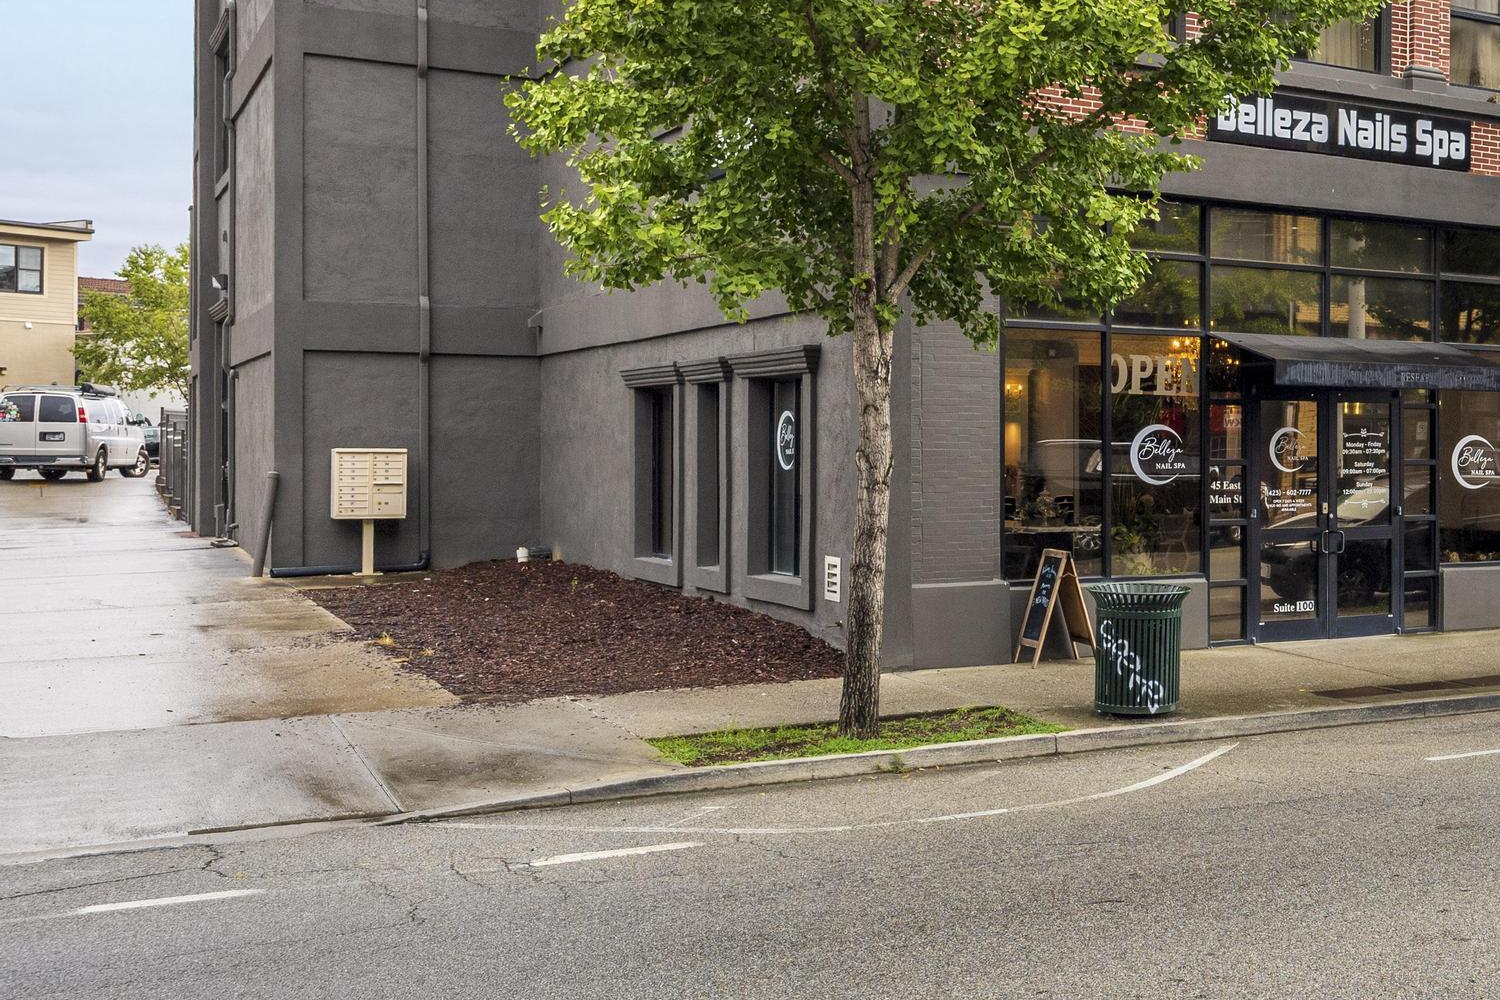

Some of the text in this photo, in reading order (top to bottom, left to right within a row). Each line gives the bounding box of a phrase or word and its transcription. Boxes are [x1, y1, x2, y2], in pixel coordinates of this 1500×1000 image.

[1338, 108, 1407, 153] Nails
[1416, 119, 1465, 166] Spa
[1139, 436, 1184, 462] Belleza
[1345, 441, 1364, 449] Monday
[1458, 446, 1494, 470] Belleza
[1210, 480, 1241, 490] 45 East
[1286, 488, 1312, 496] 602-7777
[1209, 494, 1243, 504] Main St
[1274, 601, 1314, 612] Suite 100
